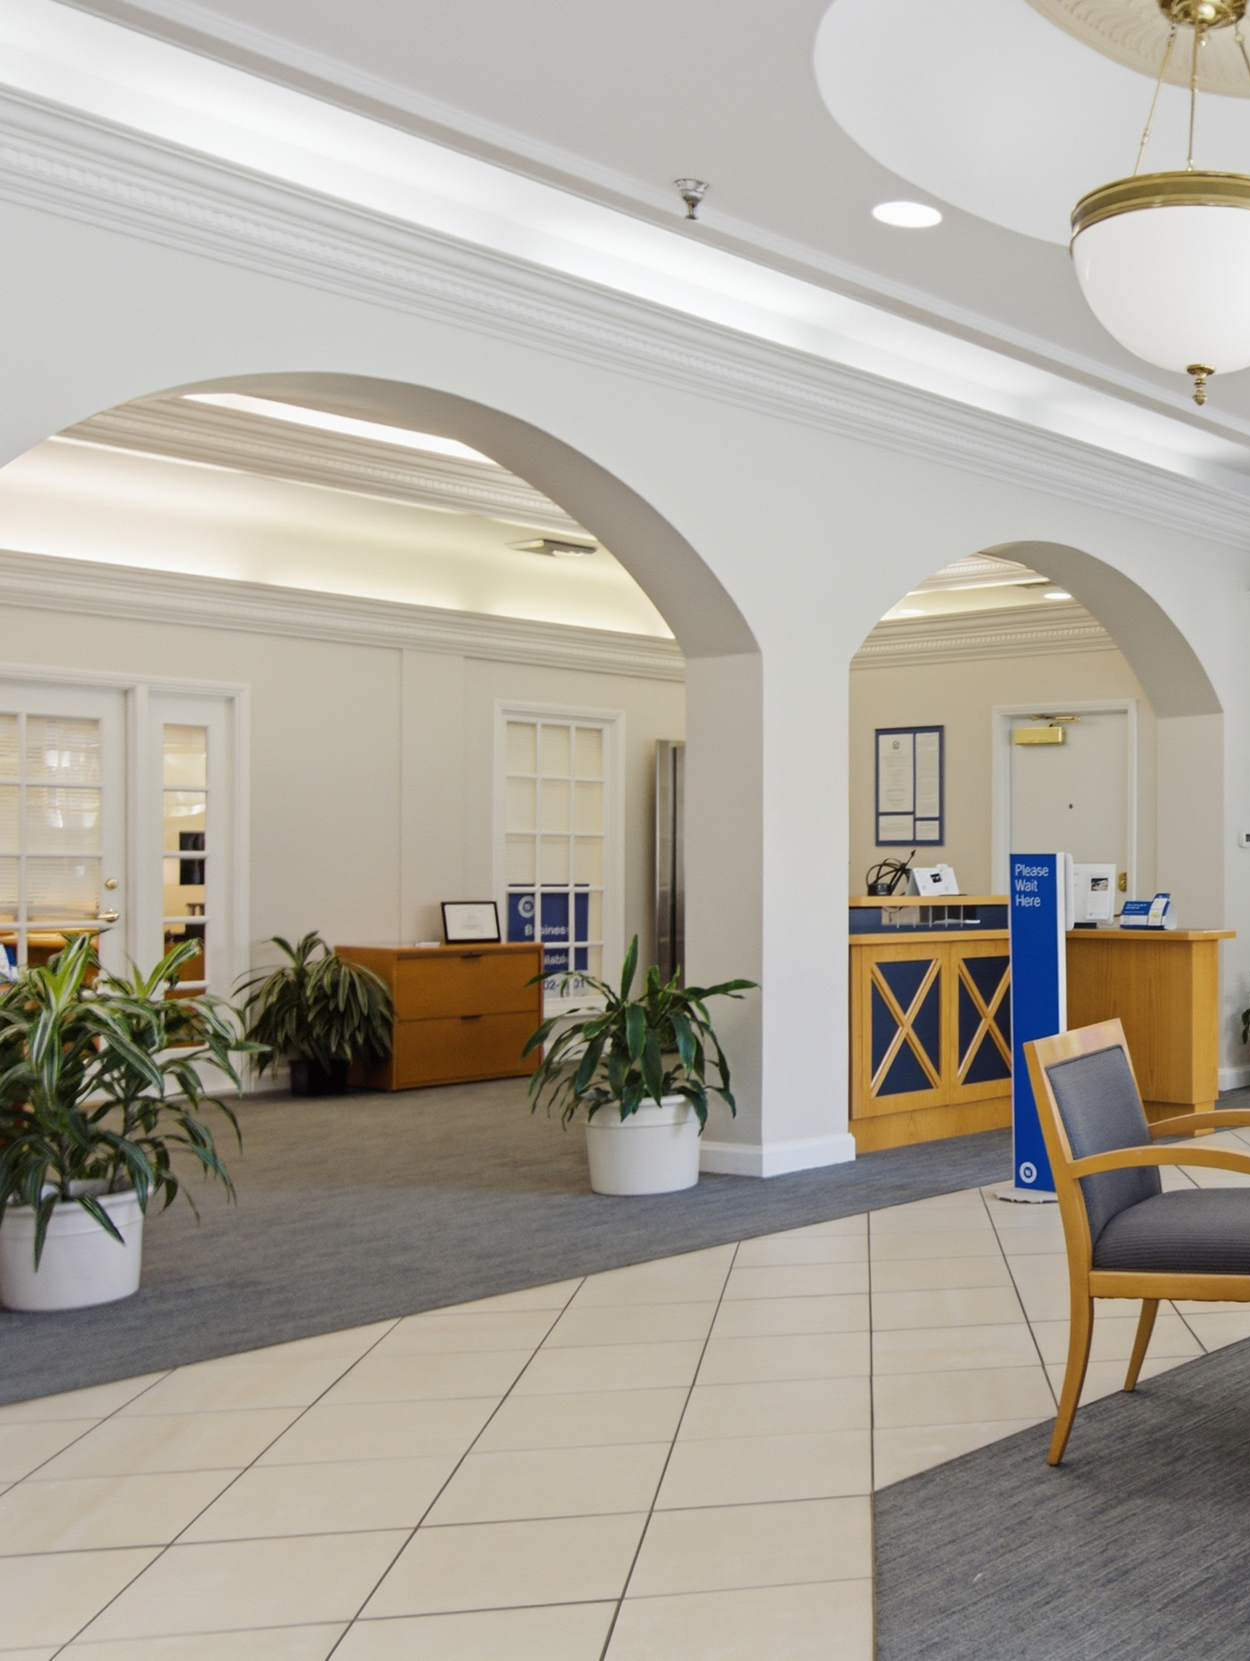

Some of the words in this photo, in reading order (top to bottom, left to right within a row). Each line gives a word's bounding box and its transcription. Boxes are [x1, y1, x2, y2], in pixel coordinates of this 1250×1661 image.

[1015, 863, 1049, 877] Please
[1015, 879, 1038, 892] Wait
[1015, 894, 1041, 907] Here
